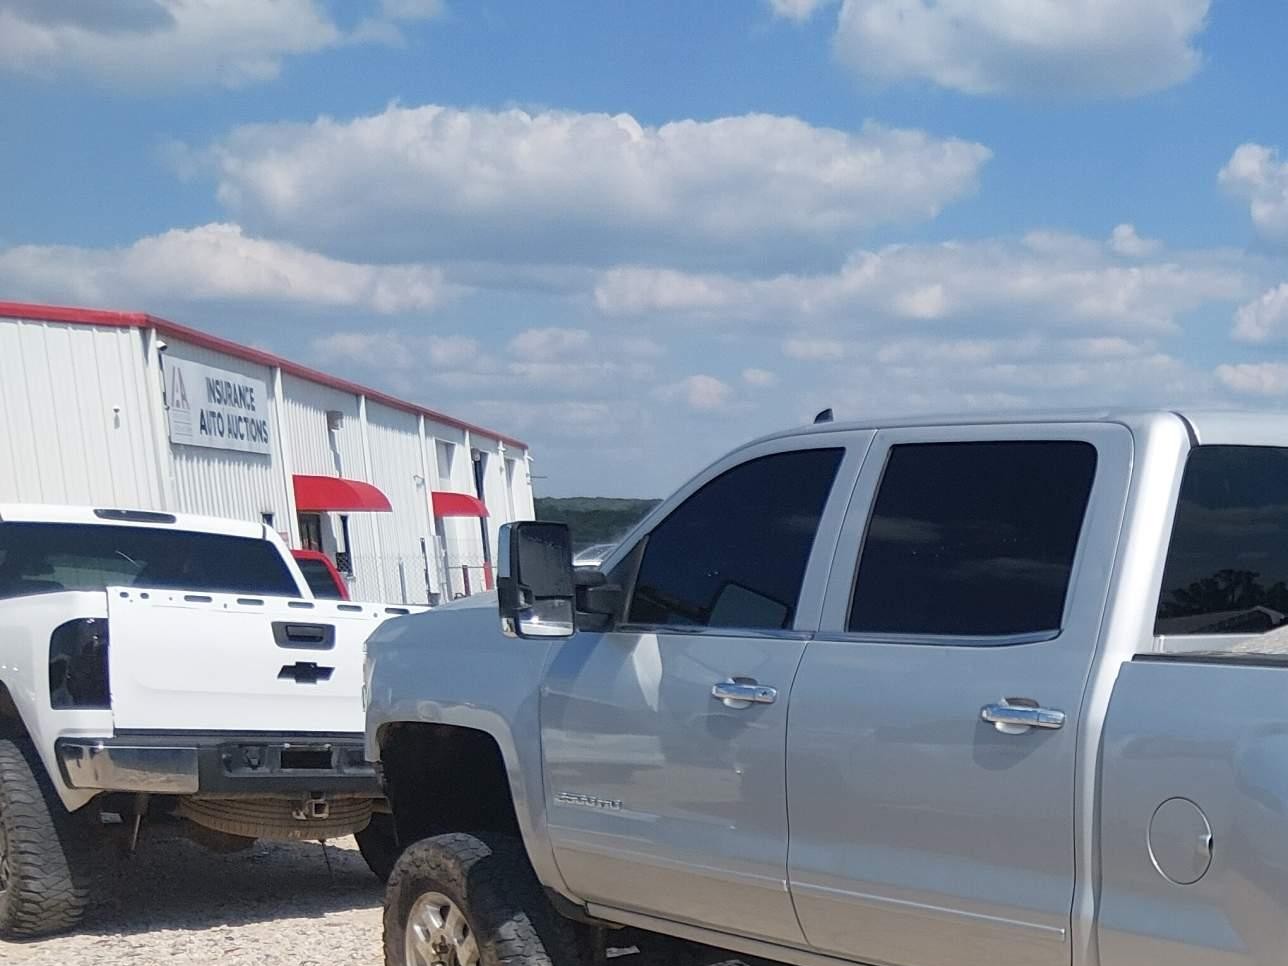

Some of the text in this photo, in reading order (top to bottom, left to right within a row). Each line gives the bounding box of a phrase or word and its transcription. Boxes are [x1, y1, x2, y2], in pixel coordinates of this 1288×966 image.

[206, 377, 255, 411] INSURANCE
[200, 409, 225, 438] AUTO
[227, 414, 268, 443] AUCTIONS
